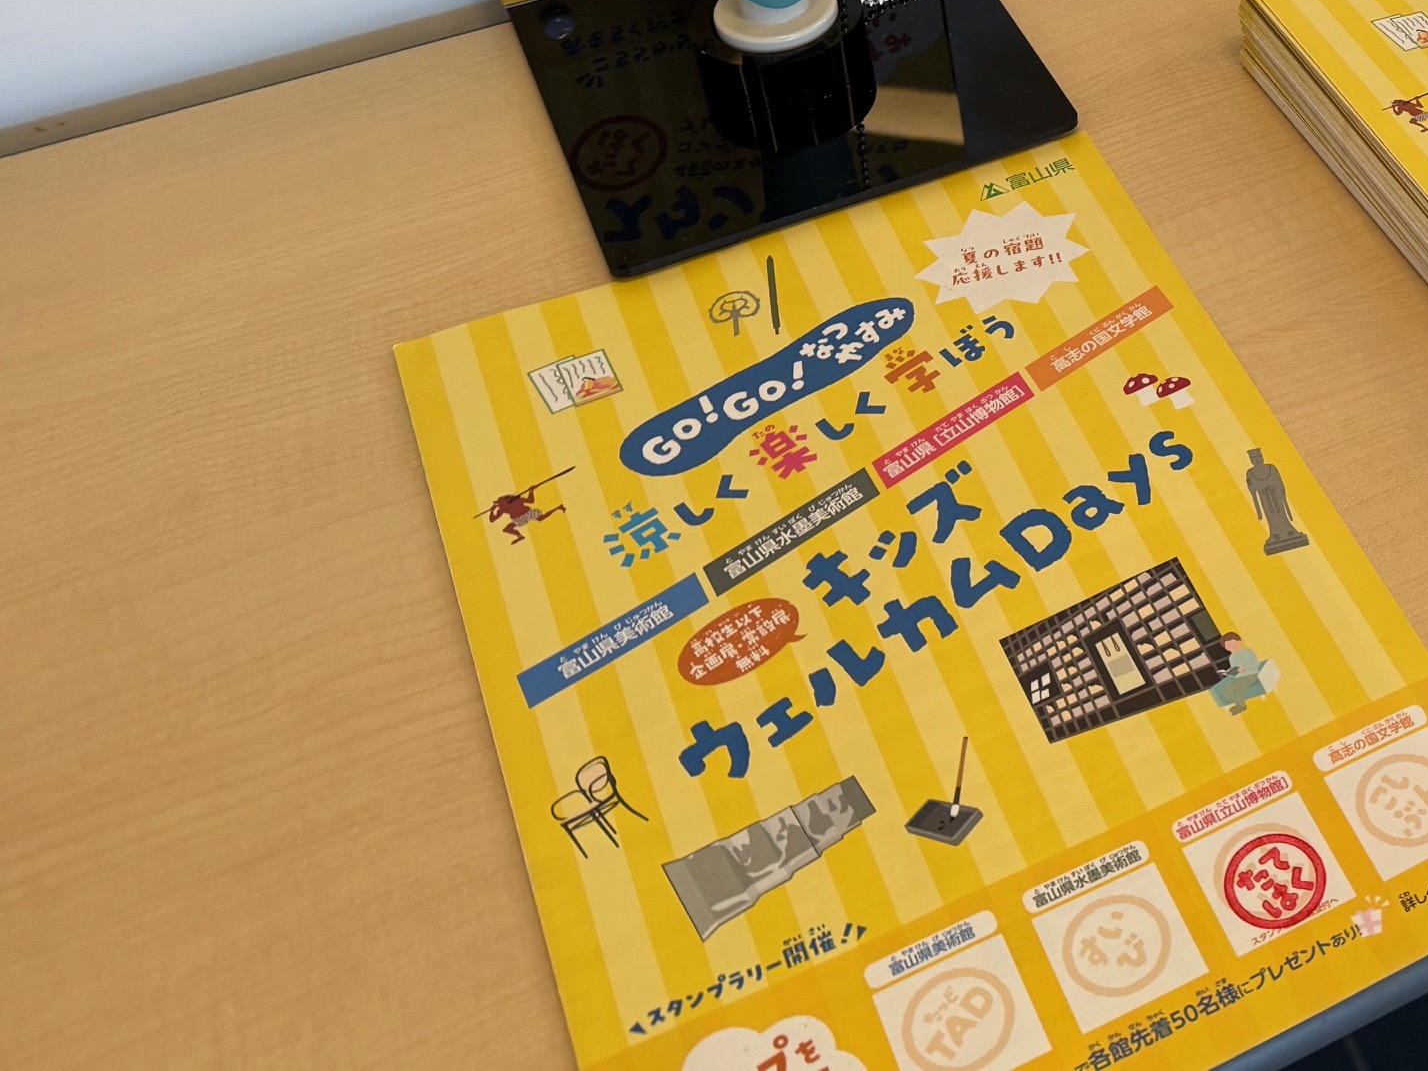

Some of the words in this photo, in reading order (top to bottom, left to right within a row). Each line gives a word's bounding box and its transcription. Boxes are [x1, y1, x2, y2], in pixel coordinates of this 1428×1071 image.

[1005, 157, 1076, 190] 富山県
[952, 252, 1064, 286] 応援します!!
[961, 236, 1044, 266] 夏の宿題
[799, 322, 848, 360] なつ
[834, 306, 906, 365] やすみ
[1050, 304, 1153, 373] 高志の国文学館
[641, 360, 805, 465] GO!GO!
[883, 385, 1025, 478] 富山県[立山博物館]
[724, 486, 864, 579] 富山県水墨美術館
[802, 460, 982, 608] キッズ
[678, 431, 1194, 779] ウェルカムDays
[690, 605, 763, 658] 高校生以下
[557, 605, 674, 679] 富山県美術館
[735, 645, 770, 673] 無料
[1328, 714, 1416, 764] 高志の国文学館
[1032, 849, 1142, 909] 富山県水墨美術館
[647, 923, 854, 1026] スタンプラリー開催!
[888, 925, 976, 977] 富山県美術館
[926, 985, 994, 1060] TAD
